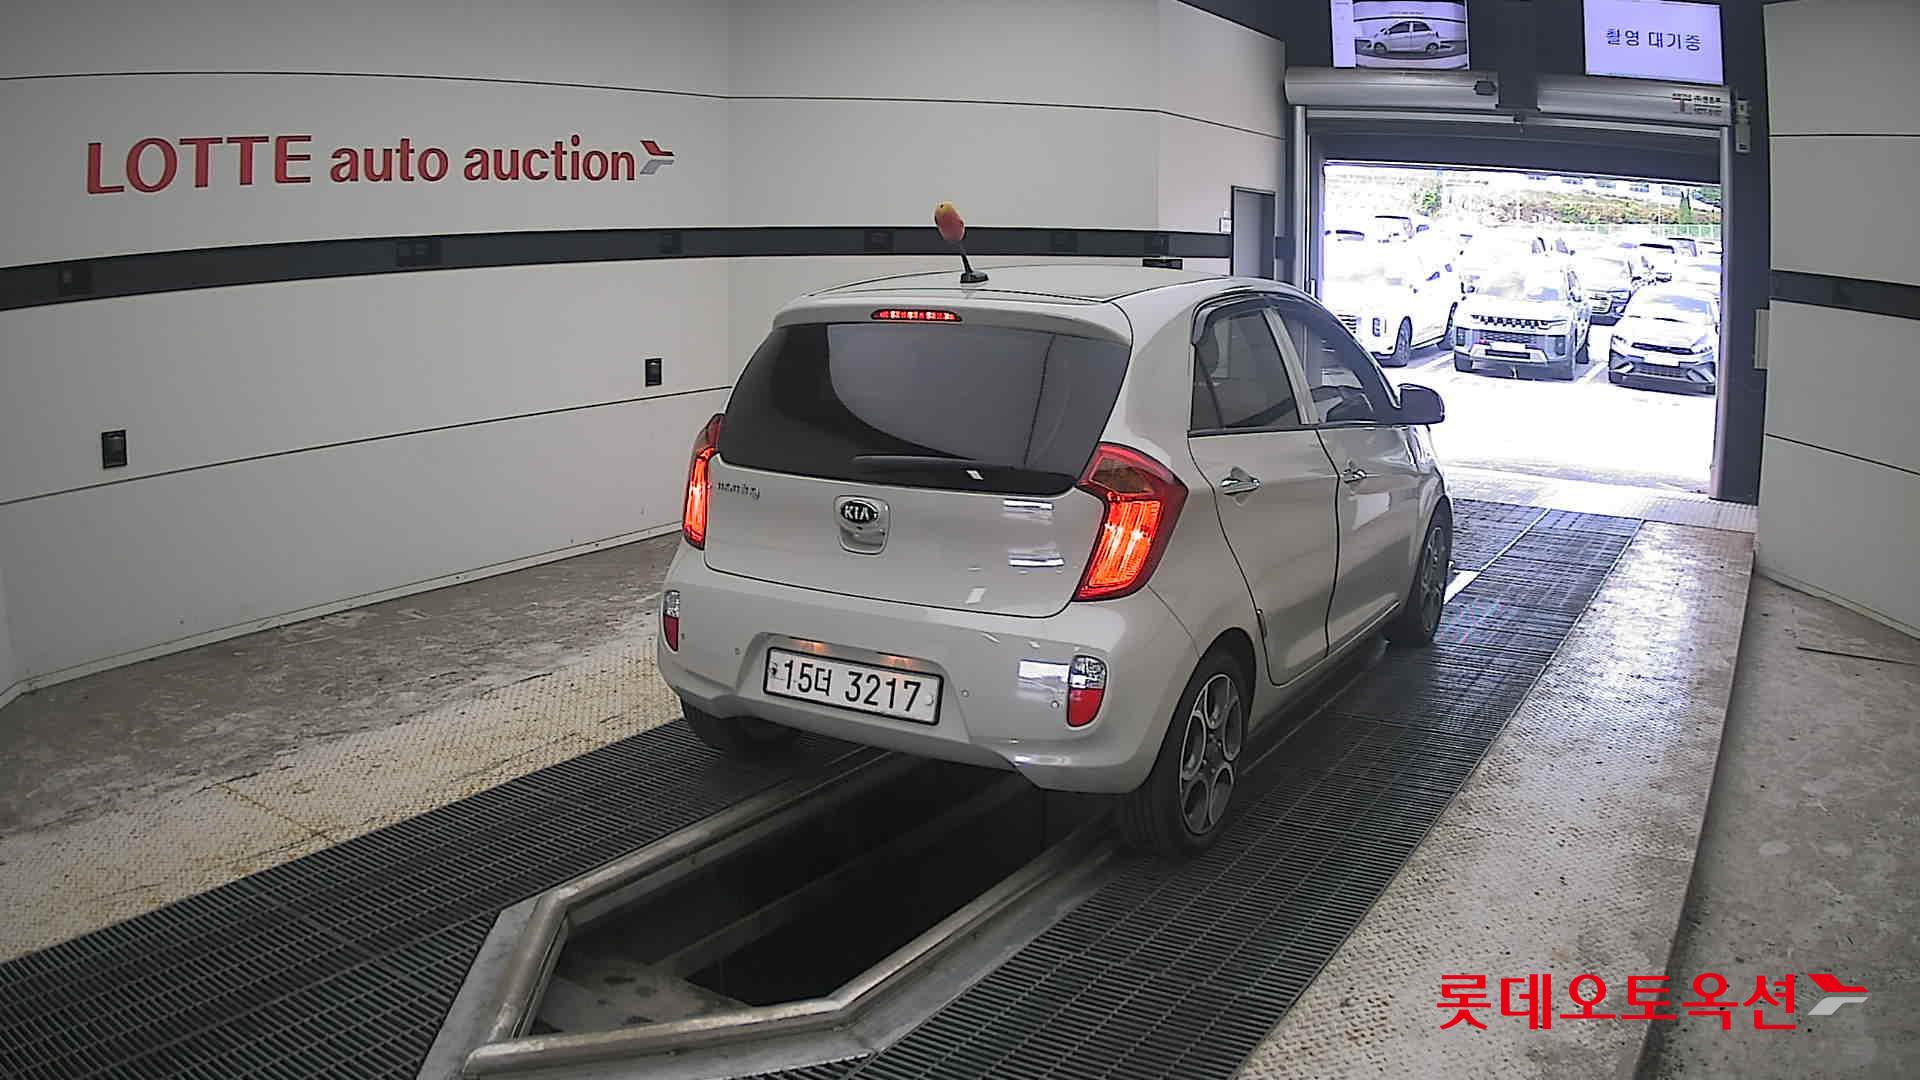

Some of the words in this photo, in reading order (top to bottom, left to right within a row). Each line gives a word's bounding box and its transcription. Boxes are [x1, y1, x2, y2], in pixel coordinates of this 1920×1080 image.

[86, 134, 313, 195] LOTTE
[329, 137, 450, 184] auto
[462, 134, 636, 183] auction
[844, 505, 870, 521] KIA
[784, 659, 832, 696] 15더
[845, 670, 921, 713] 3217
